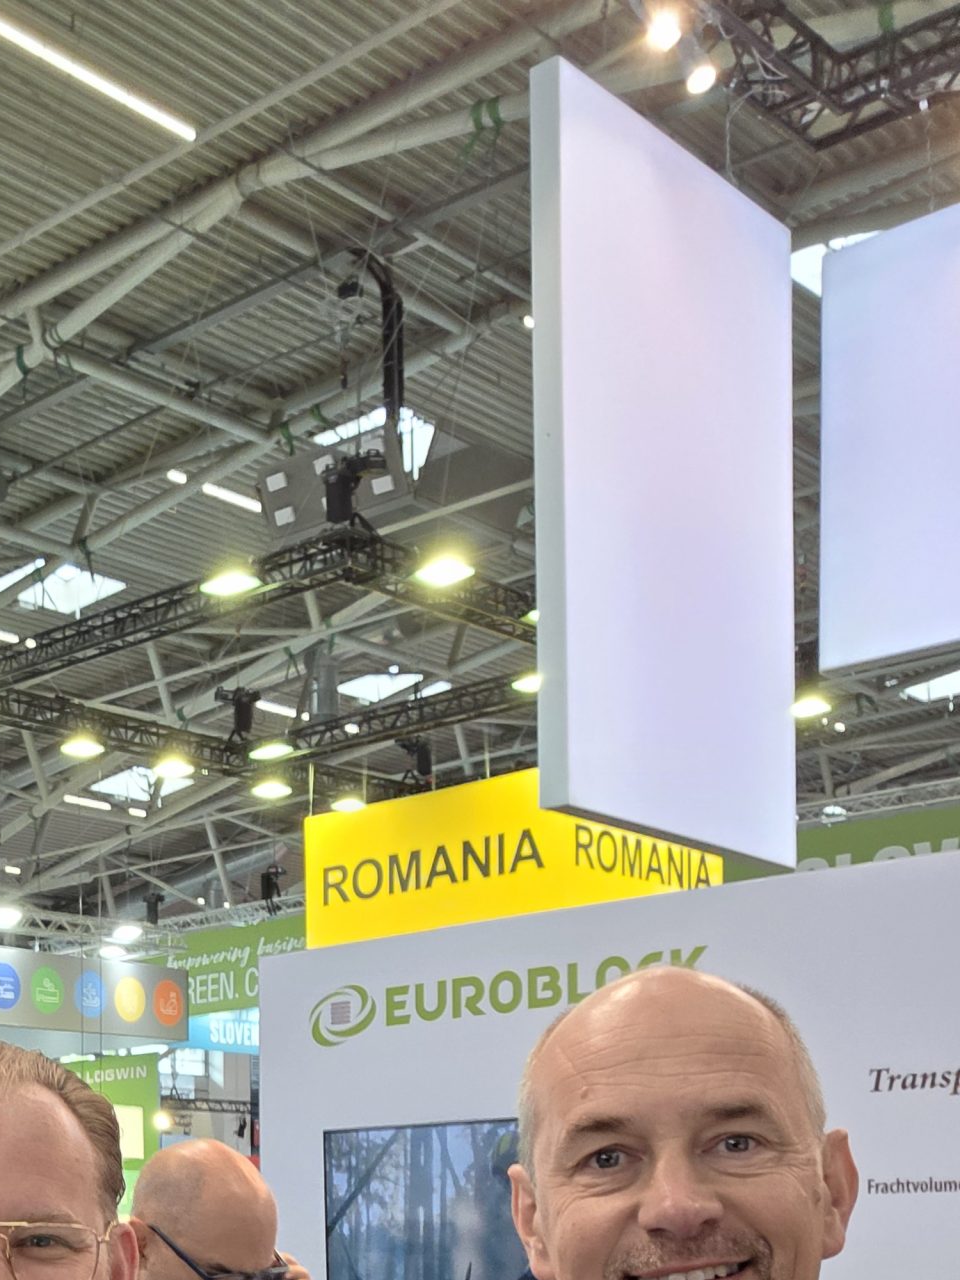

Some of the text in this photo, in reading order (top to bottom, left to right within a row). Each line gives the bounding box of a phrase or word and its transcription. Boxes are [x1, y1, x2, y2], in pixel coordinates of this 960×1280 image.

[323, 828, 545, 907] ROMANIA
[575, 823, 711, 890] ROMANIA
[167, 944, 250, 968] Empowering
[385, 944, 709, 1027] EUROBLO
[86, 1065, 148, 1083] LOGWIN
[867, 1176, 960, 1194] Frachtvolum
